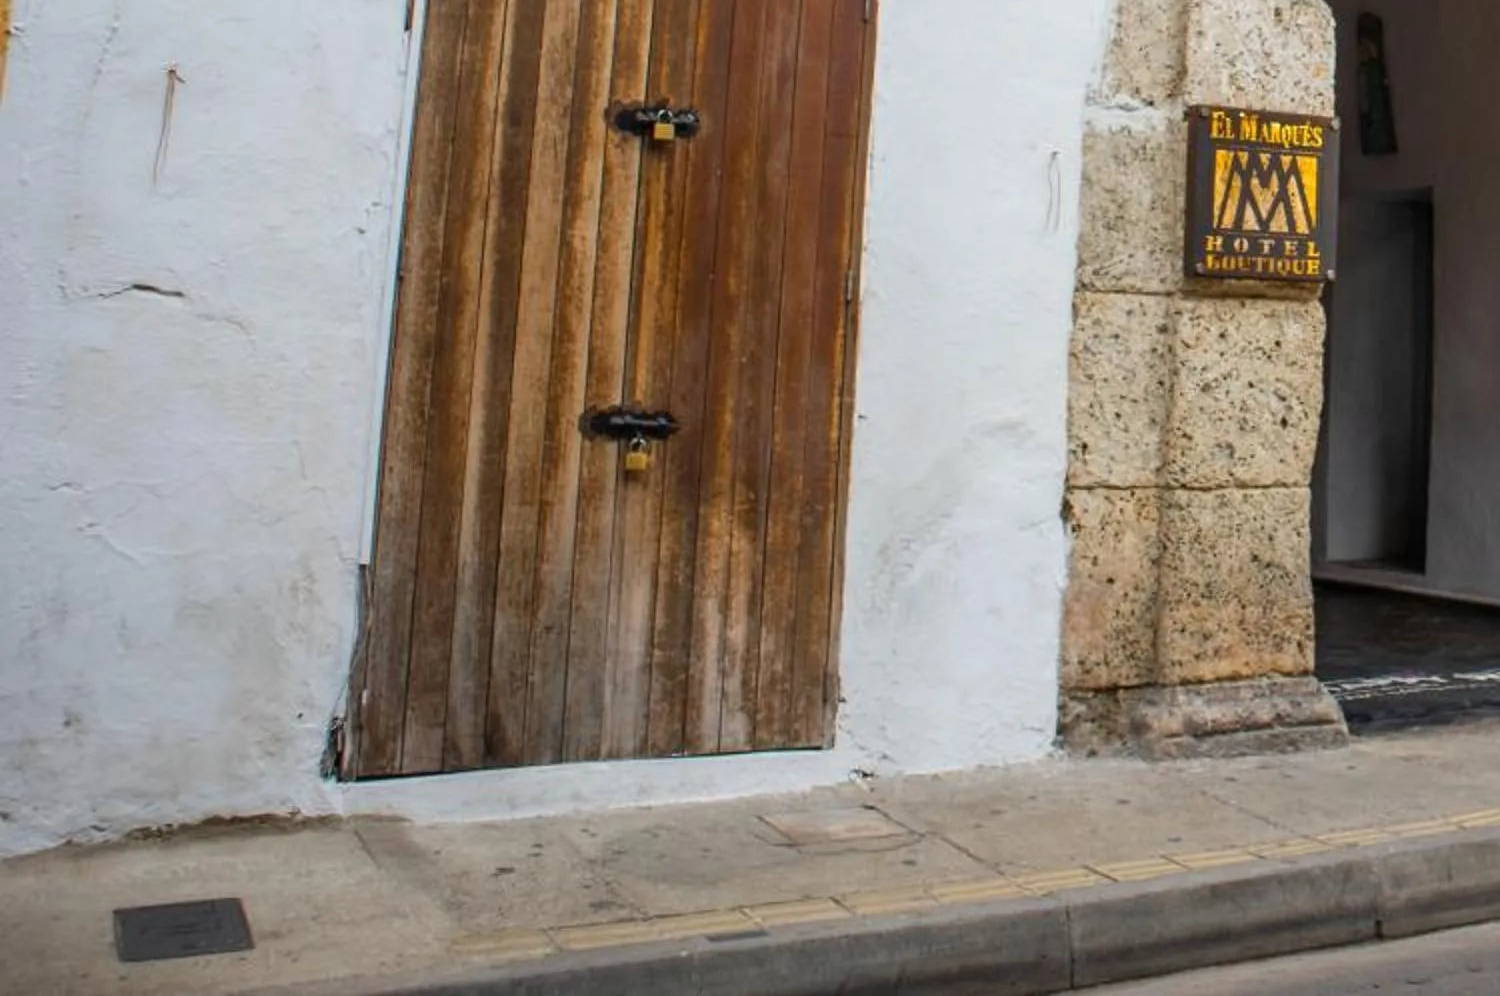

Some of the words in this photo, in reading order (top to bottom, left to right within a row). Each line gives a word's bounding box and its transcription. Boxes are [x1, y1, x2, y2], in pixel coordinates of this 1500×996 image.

[1210, 110, 1235, 139] EL
[1203, 235, 1321, 257] HOTEL
[1204, 254, 1320, 276] BOUTIQUE
